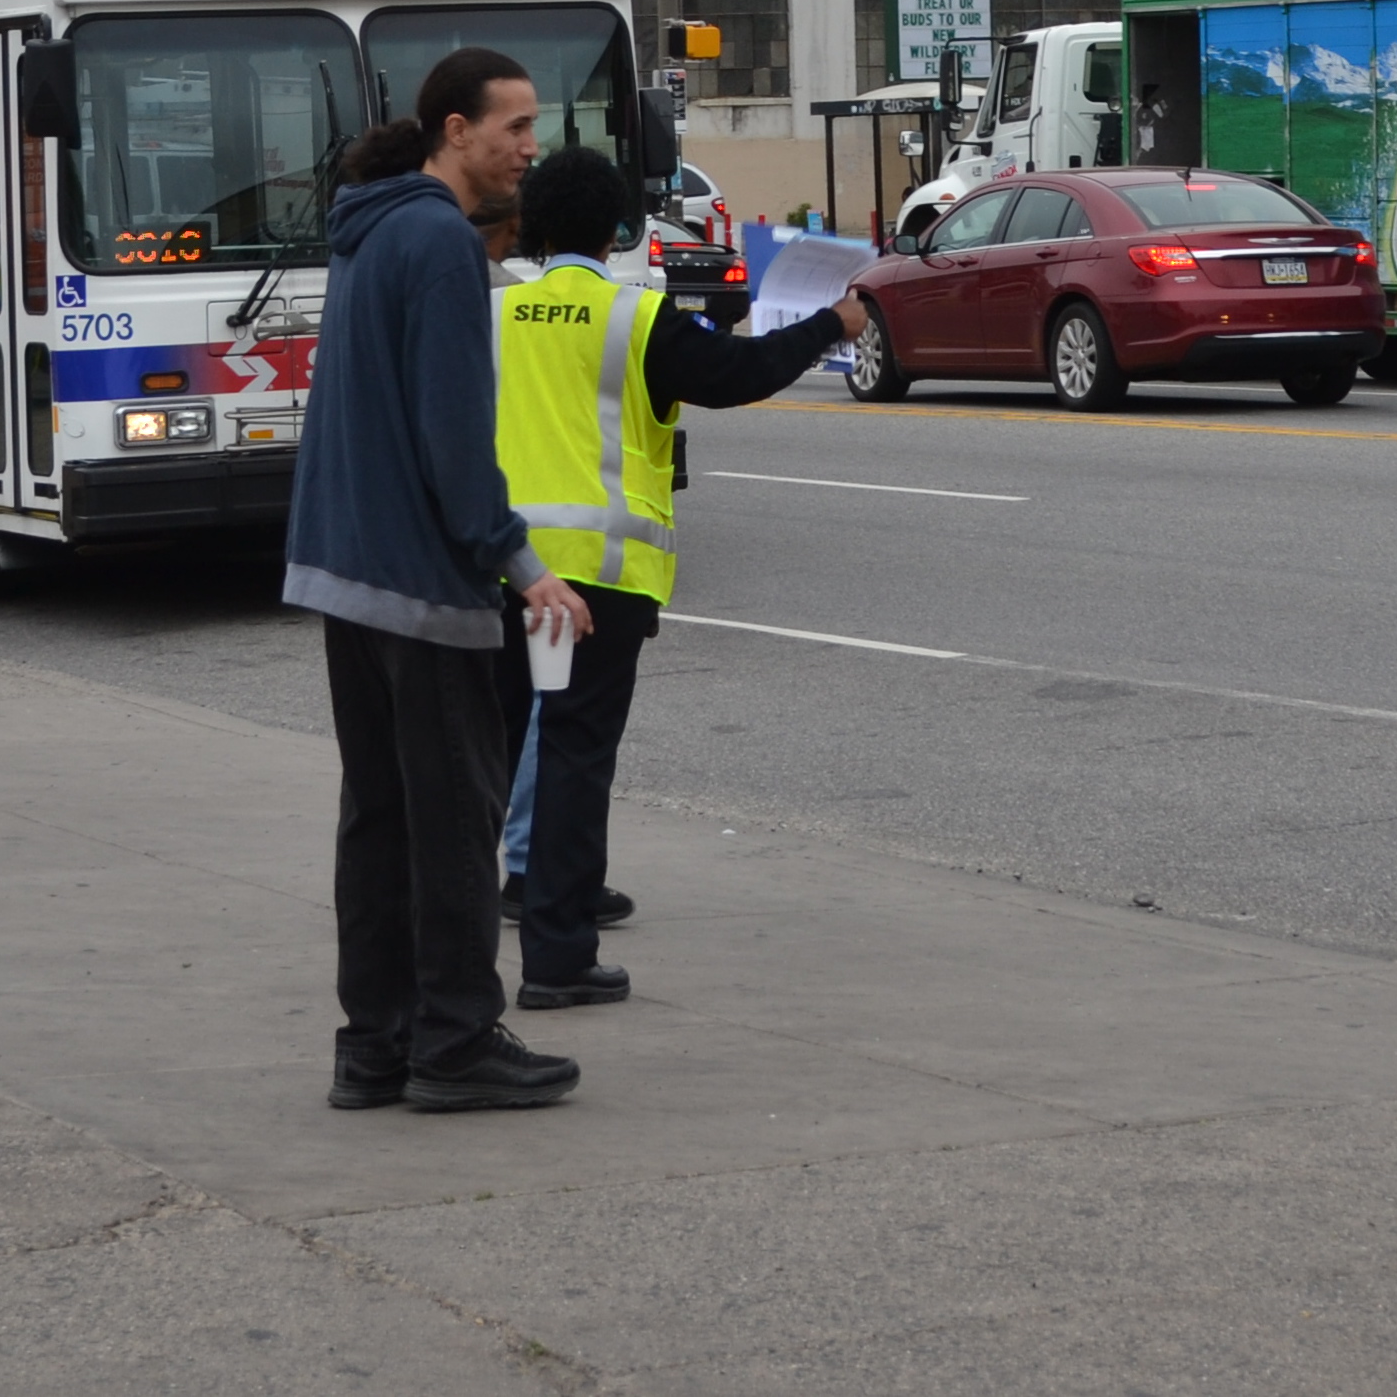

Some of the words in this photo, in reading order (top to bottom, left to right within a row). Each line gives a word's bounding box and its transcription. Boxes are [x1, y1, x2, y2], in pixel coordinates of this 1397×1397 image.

[903, 13, 932, 26] BUDS
[940, 13, 954, 26] TO
[960, 13, 981, 25] OUR
[933, 29, 955, 42] NEW
[925, 62, 971, 74] FLR
[514, 304, 591, 324] SEPTA
[62, 313, 134, 341] 5703
